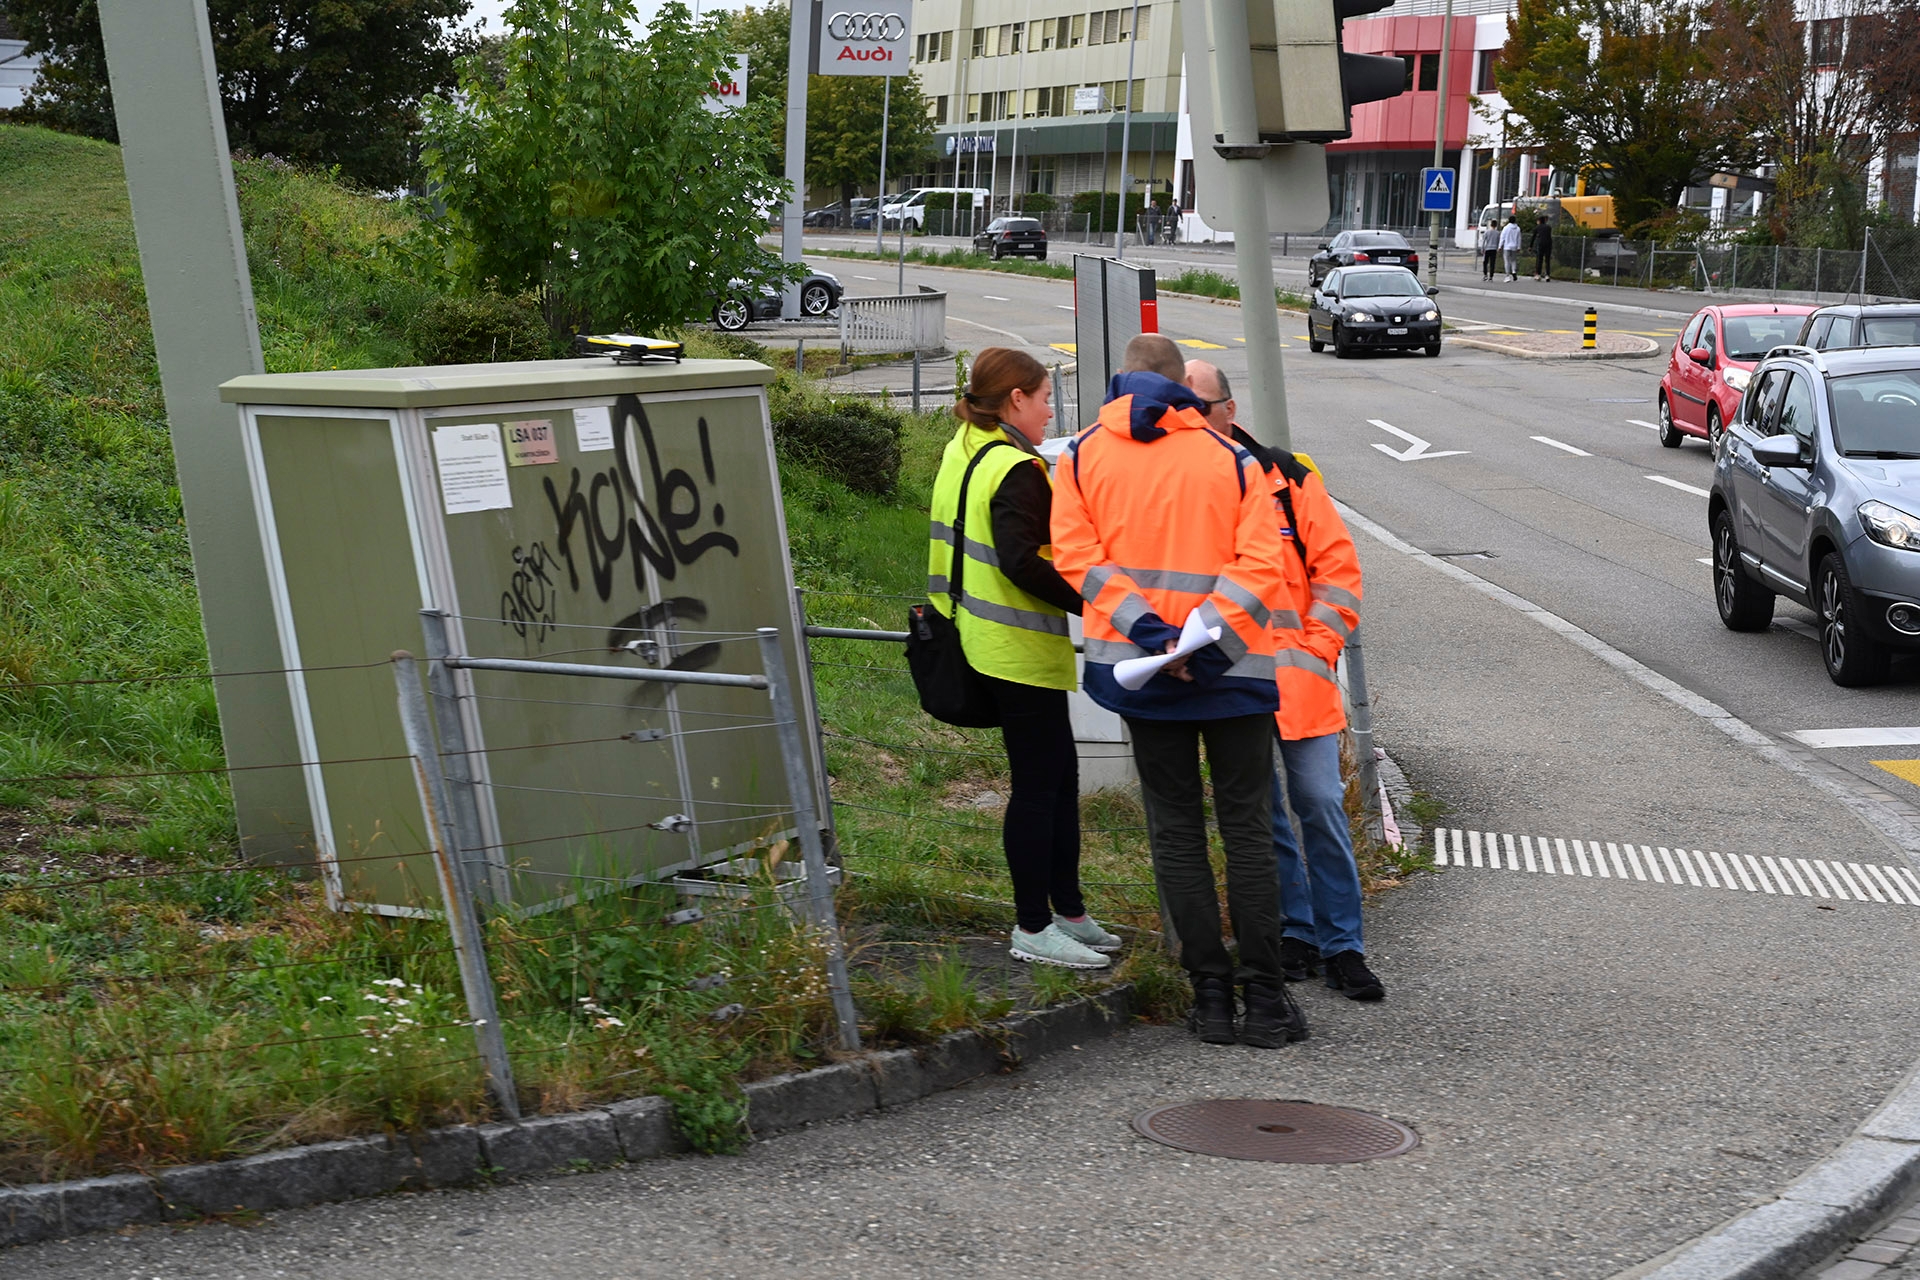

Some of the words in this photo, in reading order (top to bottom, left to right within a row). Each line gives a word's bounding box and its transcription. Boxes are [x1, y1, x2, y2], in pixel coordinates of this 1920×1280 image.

[836, 46, 893, 61] Audi
[509, 428, 531, 443] LSA
[531, 426, 548, 441] 037
